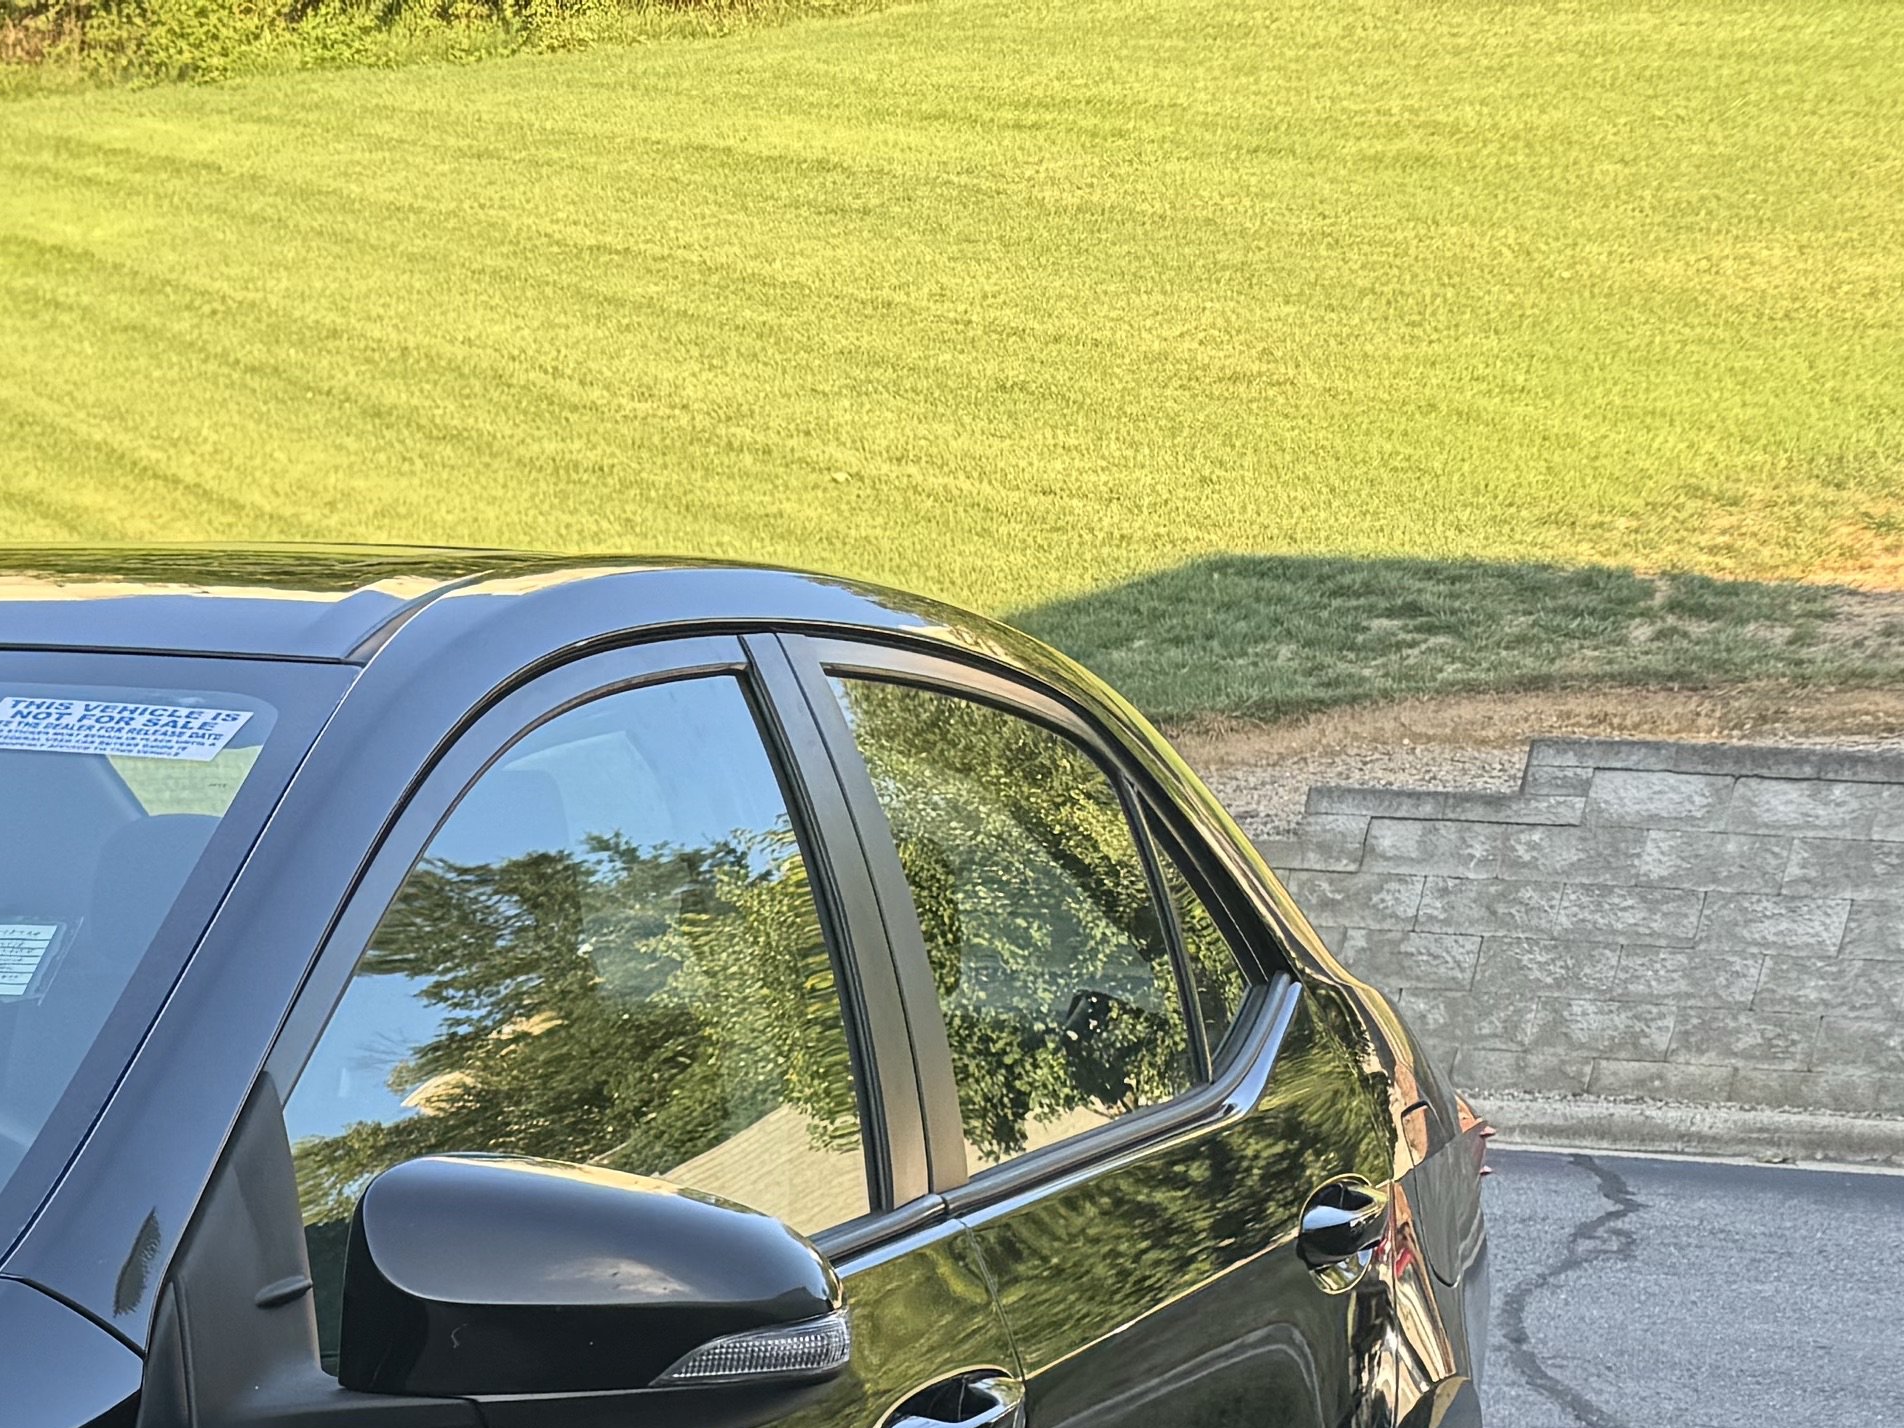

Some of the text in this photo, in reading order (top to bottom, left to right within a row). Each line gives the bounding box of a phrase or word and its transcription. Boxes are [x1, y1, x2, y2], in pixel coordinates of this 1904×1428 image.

[10, 700, 240, 722] THIS VEHICLE IS
[10, 710, 218, 731] NOT FOR SALE
[17, 721, 40, 729] THE
[42, 722, 95, 731] DEALER
[96, 726, 125, 734] FOR
[126, 728, 187, 738] RELEASE
[188, 731, 224, 740] DATE
